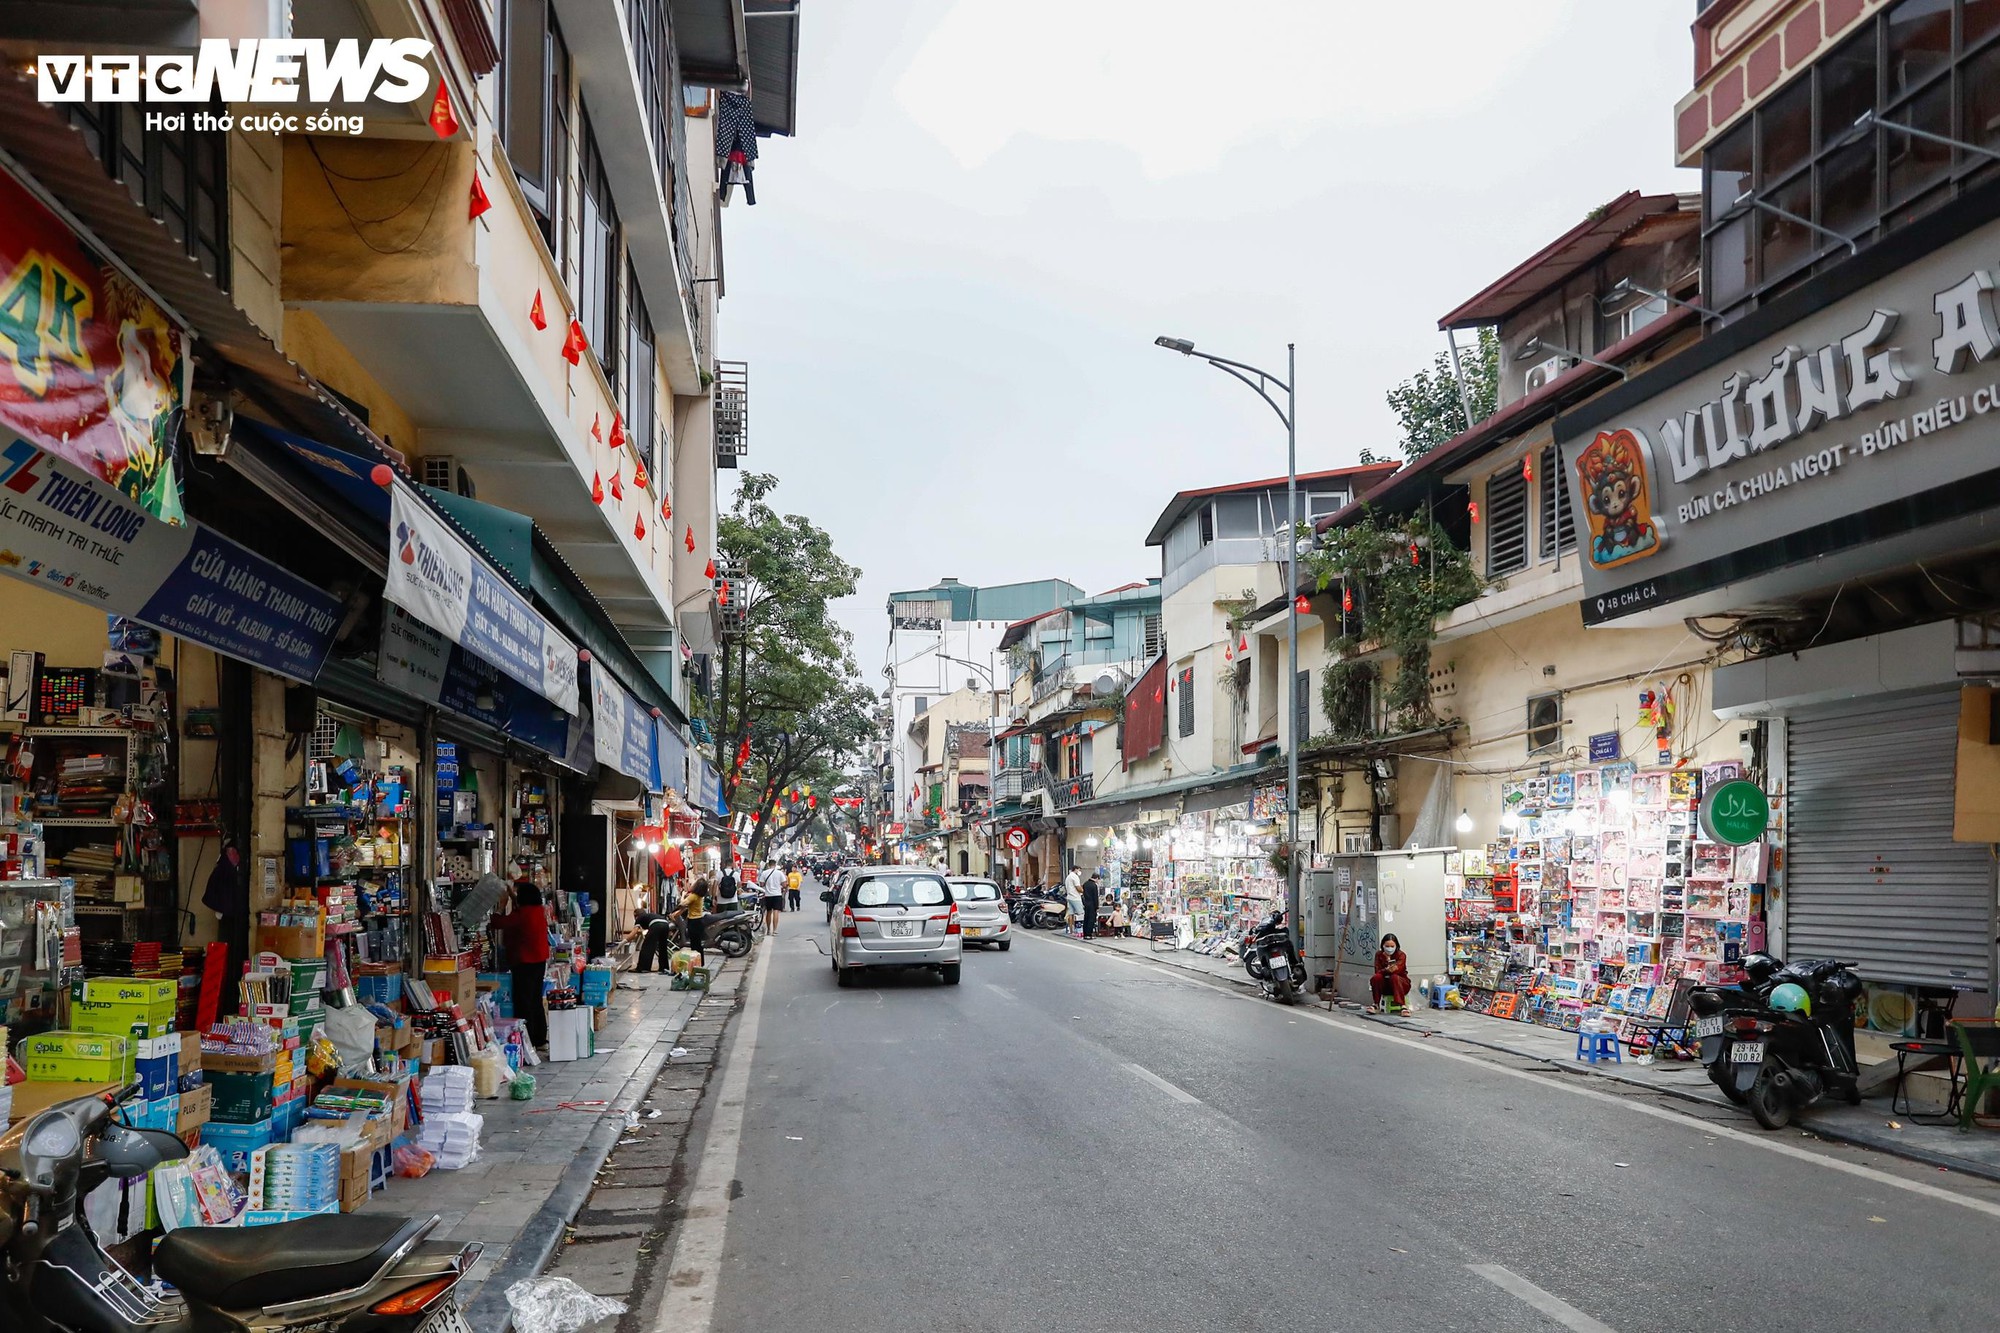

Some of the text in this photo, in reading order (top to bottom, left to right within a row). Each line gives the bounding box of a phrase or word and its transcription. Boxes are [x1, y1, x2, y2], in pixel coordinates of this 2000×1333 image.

[0, 256, 94, 390] 4K
[1659, 270, 2000, 484] VƯƠNG A
[1677, 496, 1711, 524] BÚN
[1713, 481, 1738, 511] CÁ
[1739, 467, 1789, 501] CHUA
[1790, 443, 1844, 483] NGỌT
[1861, 418, 1908, 457] BÚN
[1912, 397, 1967, 437] RIÊU
[17, 509, 65, 541] MẠNH
[66, 530, 90, 550] TRI
[90, 541, 124, 566] THỨC
[37, 470, 146, 544] THIÊN LONG
[191, 548, 226, 583] CỬA
[223, 565, 267, 602] HÀNG
[264, 586, 309, 623] THANH
[1607, 597, 1619, 609] 4B
[186, 592, 218, 619] GIẤY
[235, 616, 273, 644] ALBUM
[287, 636, 313, 659] SÁCH
[1718, 794, 1760, 818] حلال
[1726, 820, 1751, 831] HALAL
[183, 1103, 196, 1115] PLUS
